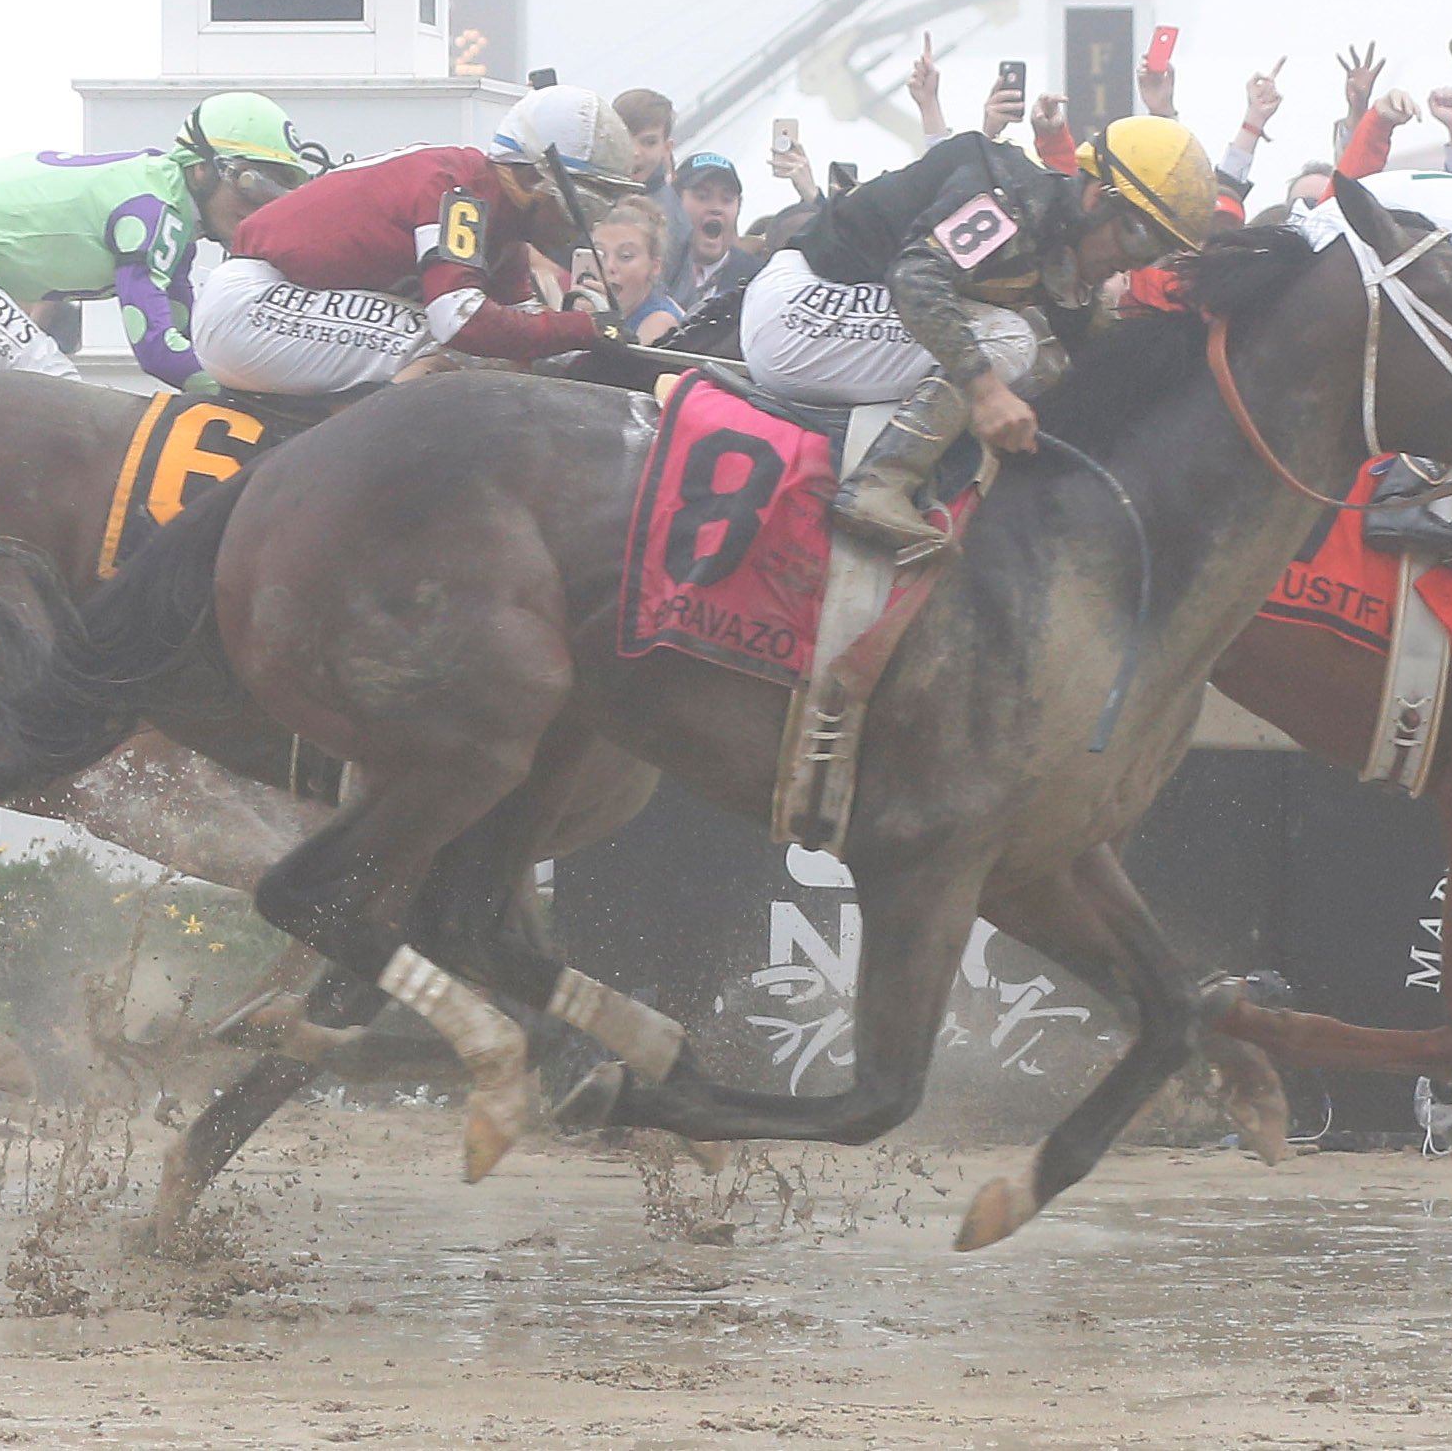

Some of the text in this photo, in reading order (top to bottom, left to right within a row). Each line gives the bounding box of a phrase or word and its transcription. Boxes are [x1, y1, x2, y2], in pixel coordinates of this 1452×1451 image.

[153, 212, 183, 273] 5
[448, 201, 481, 260] 6
[950, 209, 1002, 256] 8
[256, 283, 428, 335] JEFF RUBY'S
[784, 313, 915, 344] STEAKHOUS
[146, 402, 265, 526] 6
[665, 427, 786, 588] 8
[1282, 567, 1394, 632] USTIF
